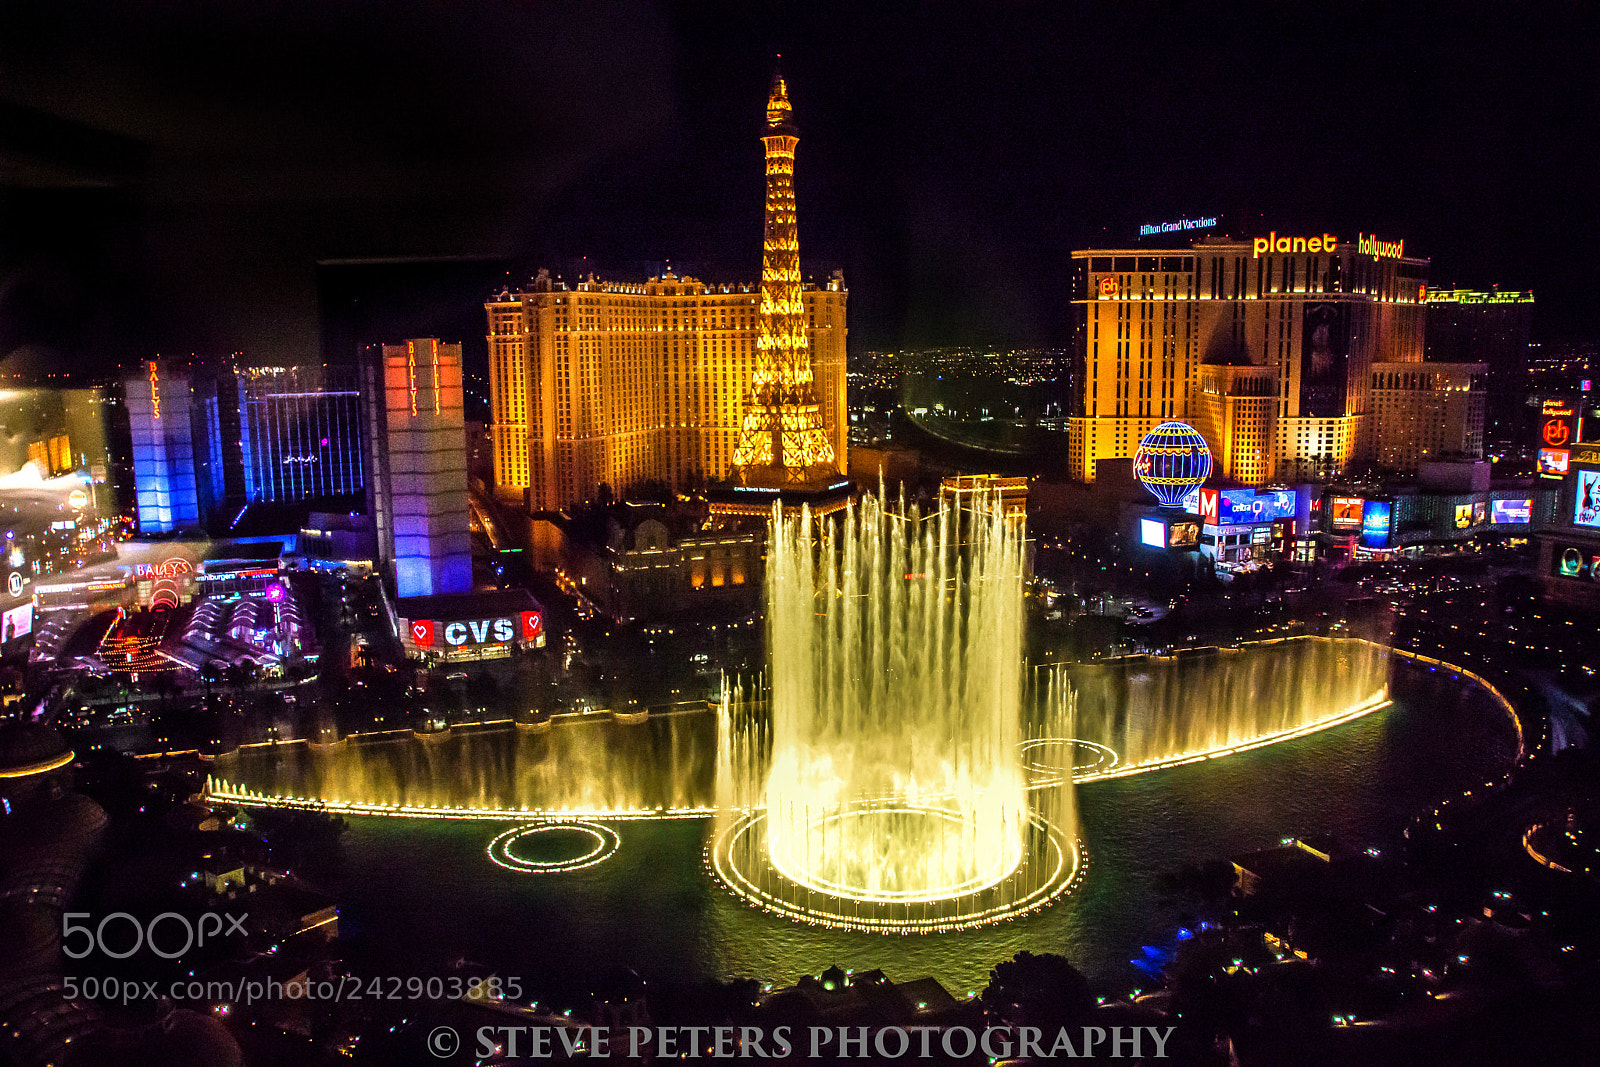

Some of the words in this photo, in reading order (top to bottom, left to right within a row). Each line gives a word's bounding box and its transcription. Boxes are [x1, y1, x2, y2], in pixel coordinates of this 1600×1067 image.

[1140, 224, 1161, 236] Hilton
[1161, 221, 1182, 233] Grand
[1253, 231, 1338, 259] planet
[1358, 232, 1404, 262] hollywood
[1542, 408, 1573, 416] hollywood
[1543, 399, 1565, 408] planet
[1201, 491, 1217, 518] M
[445, 618, 514, 646] CVS
